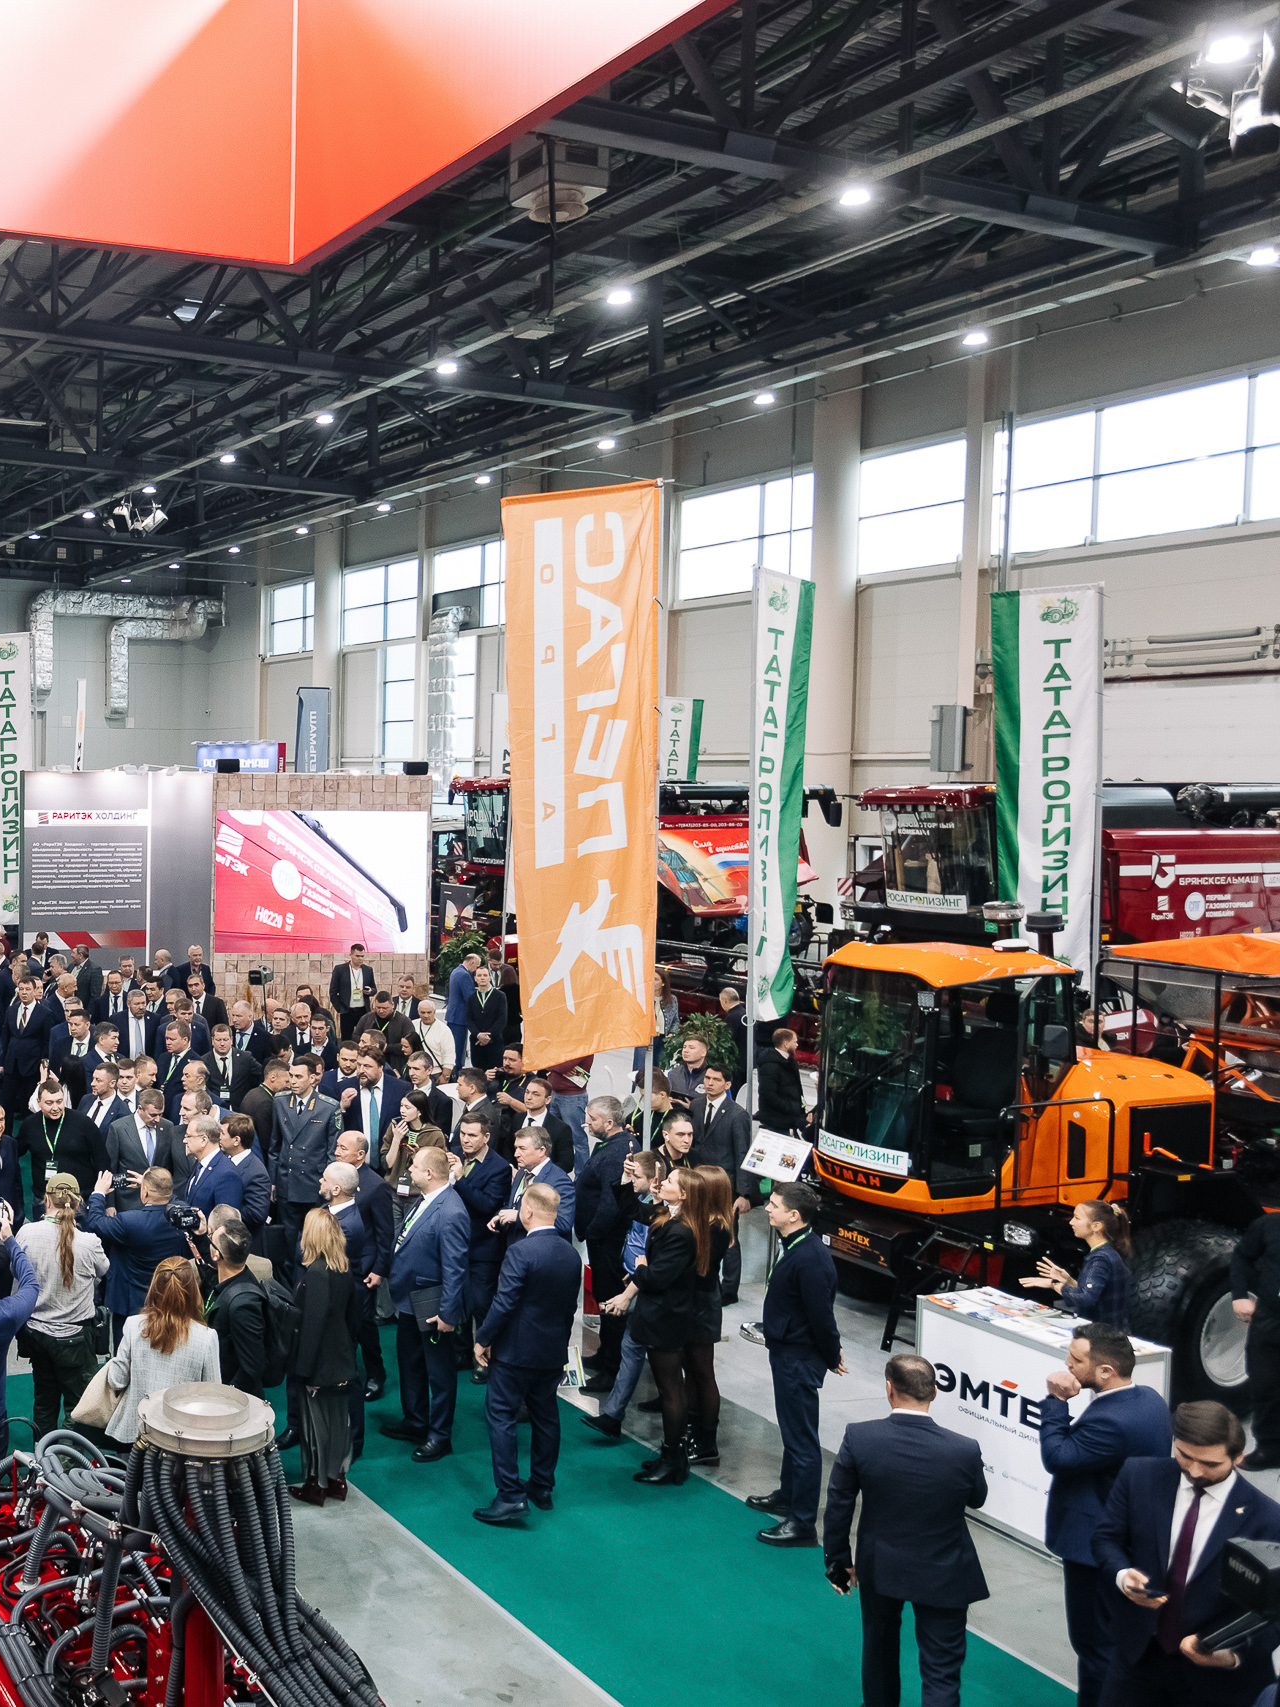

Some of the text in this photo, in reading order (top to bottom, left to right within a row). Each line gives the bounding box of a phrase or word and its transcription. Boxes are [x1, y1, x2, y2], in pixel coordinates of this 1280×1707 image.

[666, 719, 682, 780] ТАТАГР
[52, 812, 137, 820] РАРИТЭК ХОЛДИНГ
[693, 840, 713, 848] Сила
[267, 830, 354, 896] БРЯНСКСЕЛЬМАШ
[1179, 875, 1259, 885] БРЯНСКСЕЛЬМАШ
[1205, 901, 1254, 909] ГАЗОМОТОРНЫЙ
[1205, 910, 1234, 918] КОМБАЙН
[255, 906, 283, 928] H0220
[825, 1161, 881, 1187] ТУМАН
[838, 1227, 870, 1246] ЭМТЕХ
[933, 1362, 1044, 1431] ЭМТЕ
[958, 1405, 1040, 1445] ОФИЦИАЛЬНЫЙ ДИЛЕ
